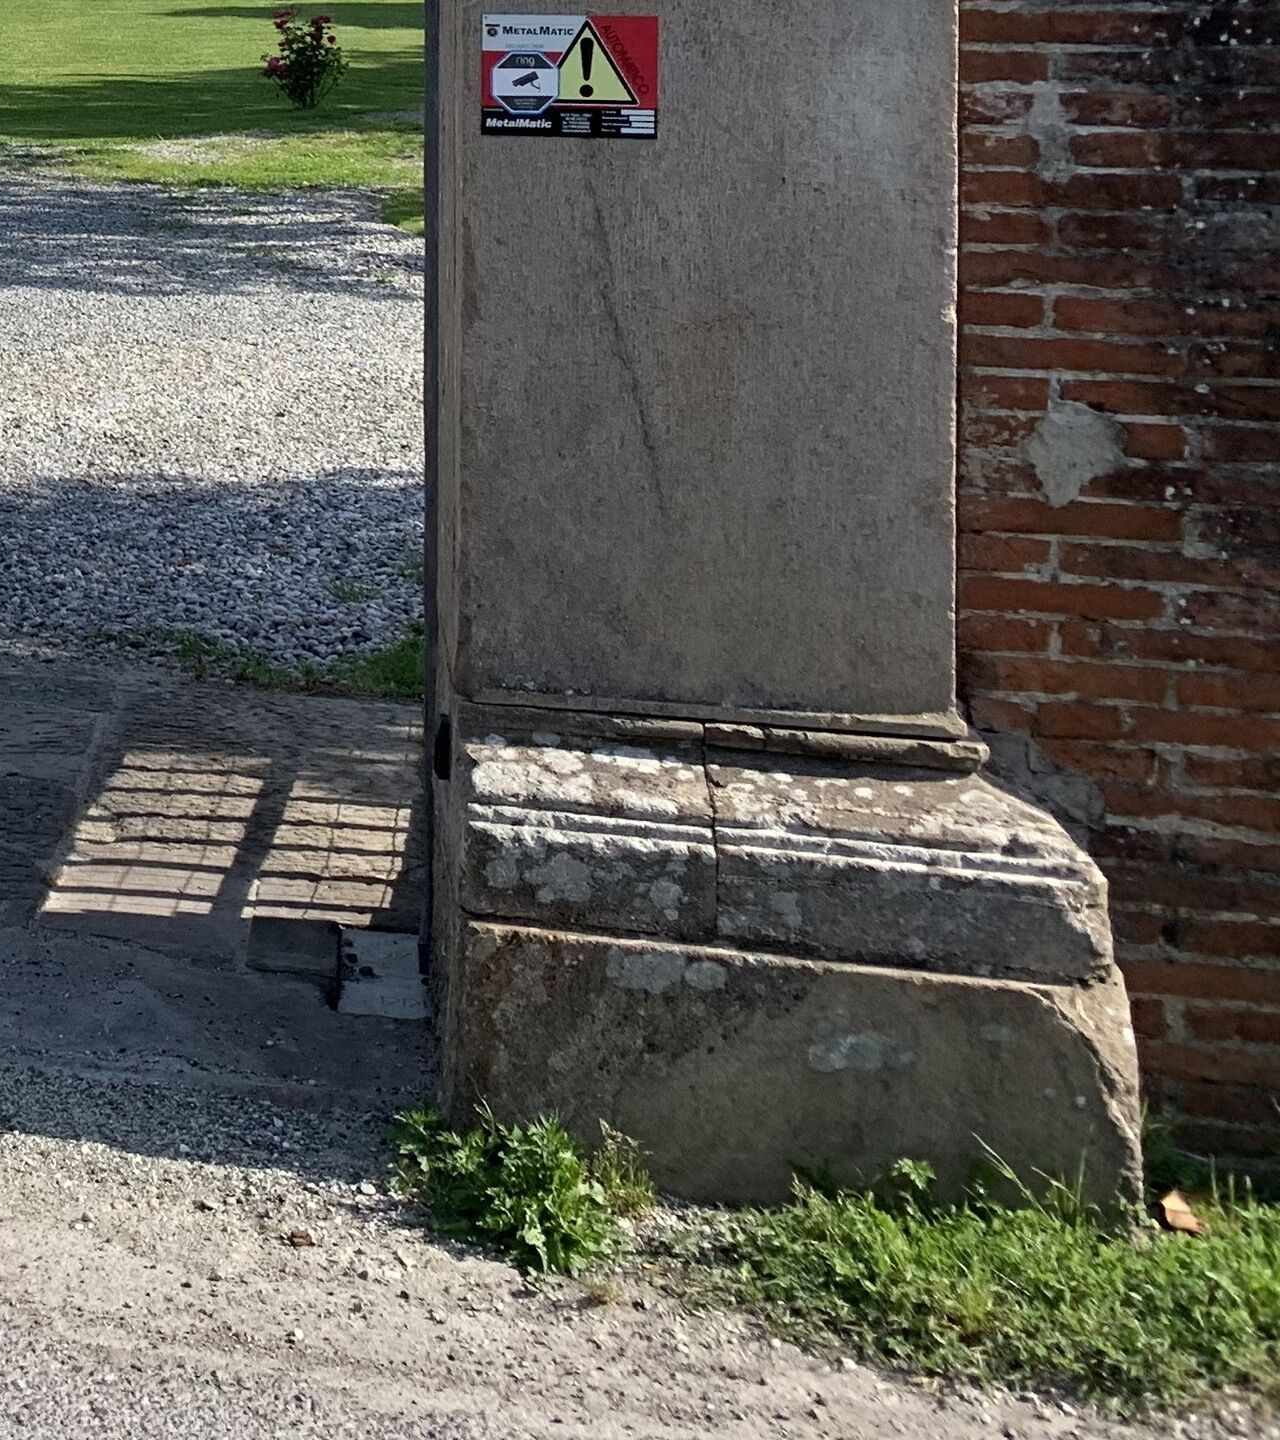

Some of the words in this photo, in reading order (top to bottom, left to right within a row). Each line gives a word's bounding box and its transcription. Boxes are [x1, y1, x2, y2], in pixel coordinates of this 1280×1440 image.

[516, 55, 535, 66] ring
[601, 25, 649, 94] AUTOMATICO
[485, 118, 552, 128] MetalMatic
